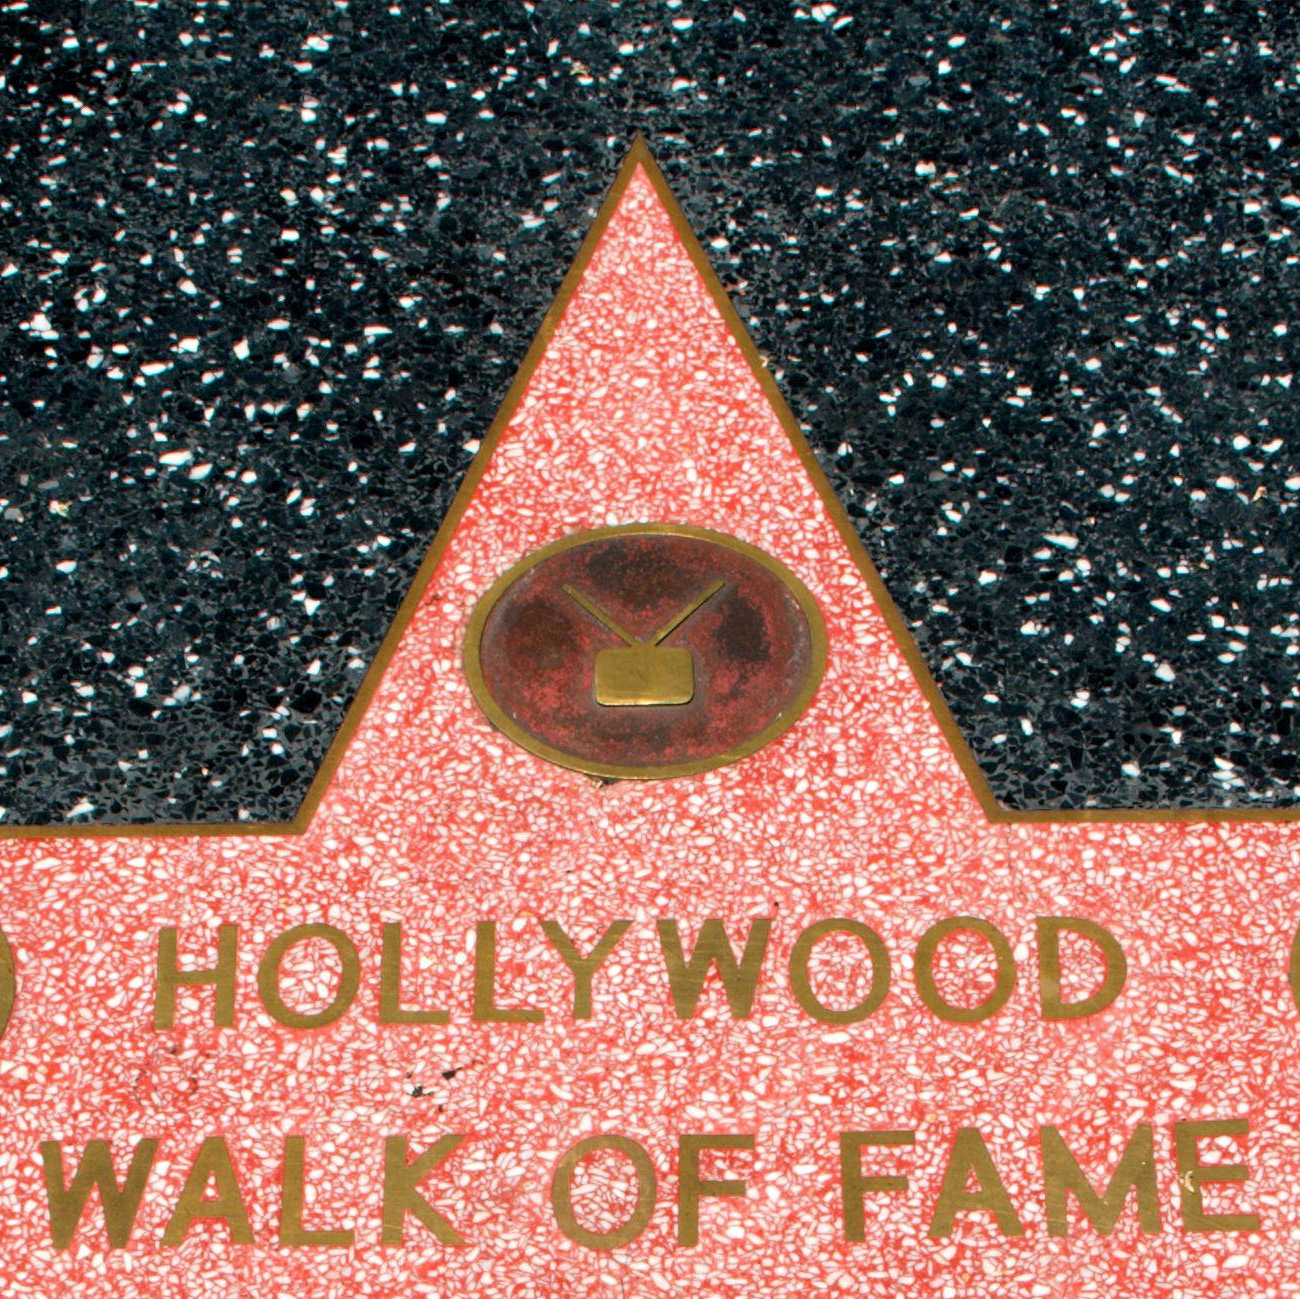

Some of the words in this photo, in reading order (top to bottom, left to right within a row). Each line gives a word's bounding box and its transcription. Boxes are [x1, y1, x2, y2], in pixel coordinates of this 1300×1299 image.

[154, 918, 1127, 1028] HOLLYWOOD
[41, 1134, 468, 1250] WALK
[551, 1134, 757, 1250] OF
[839, 1119, 1261, 1242] FAME
